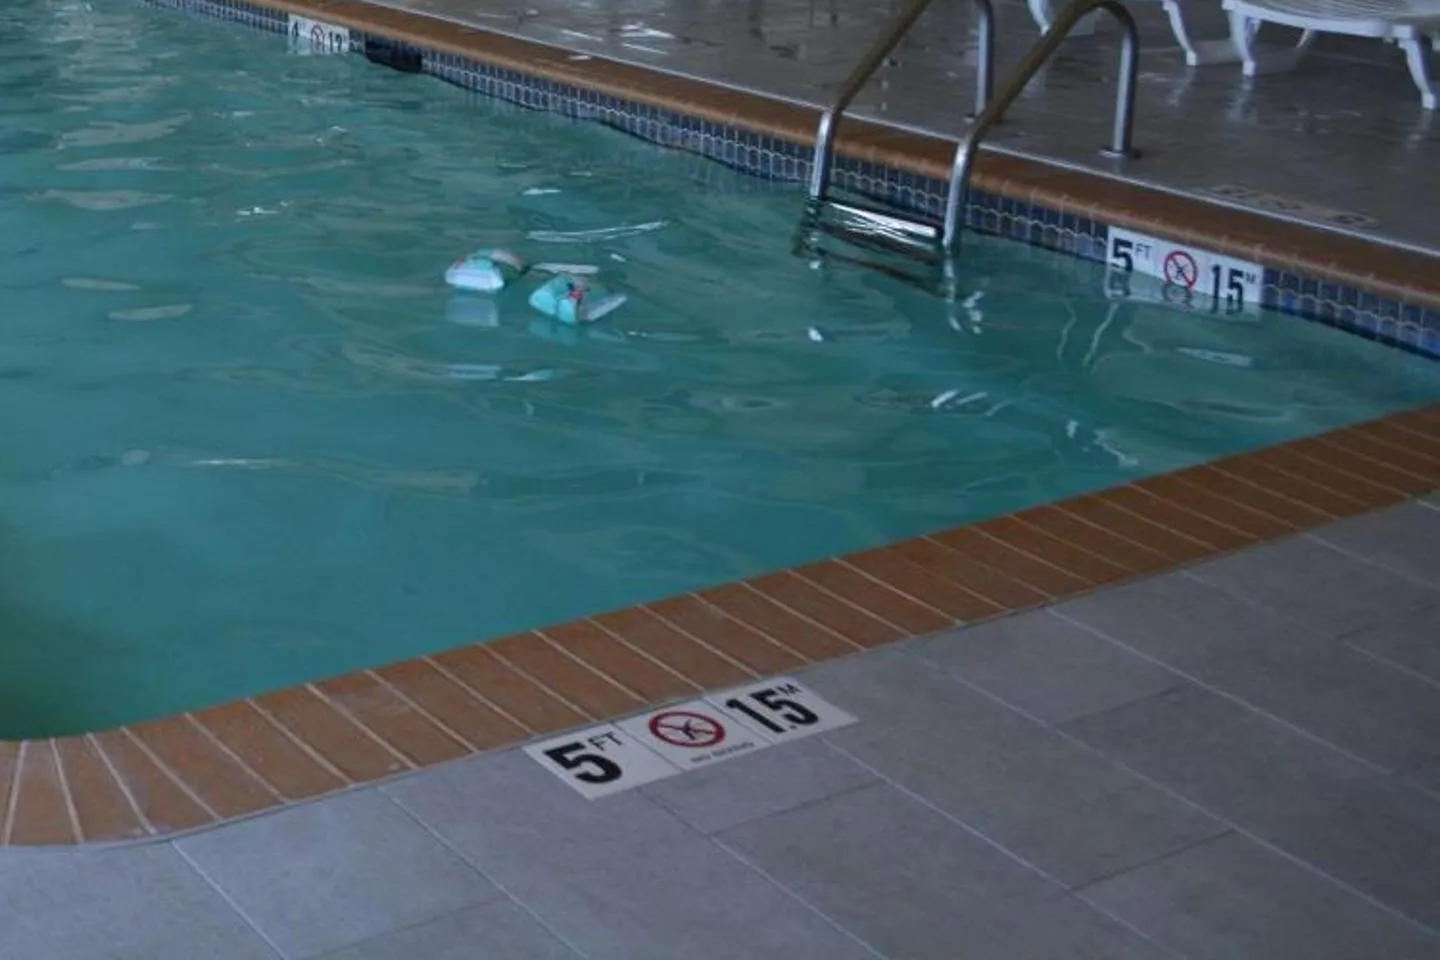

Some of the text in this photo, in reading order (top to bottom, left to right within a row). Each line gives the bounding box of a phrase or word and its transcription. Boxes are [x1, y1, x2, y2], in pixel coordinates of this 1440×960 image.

[1113, 238, 1133, 272] 5
[542, 731, 623, 784] 5 FT
